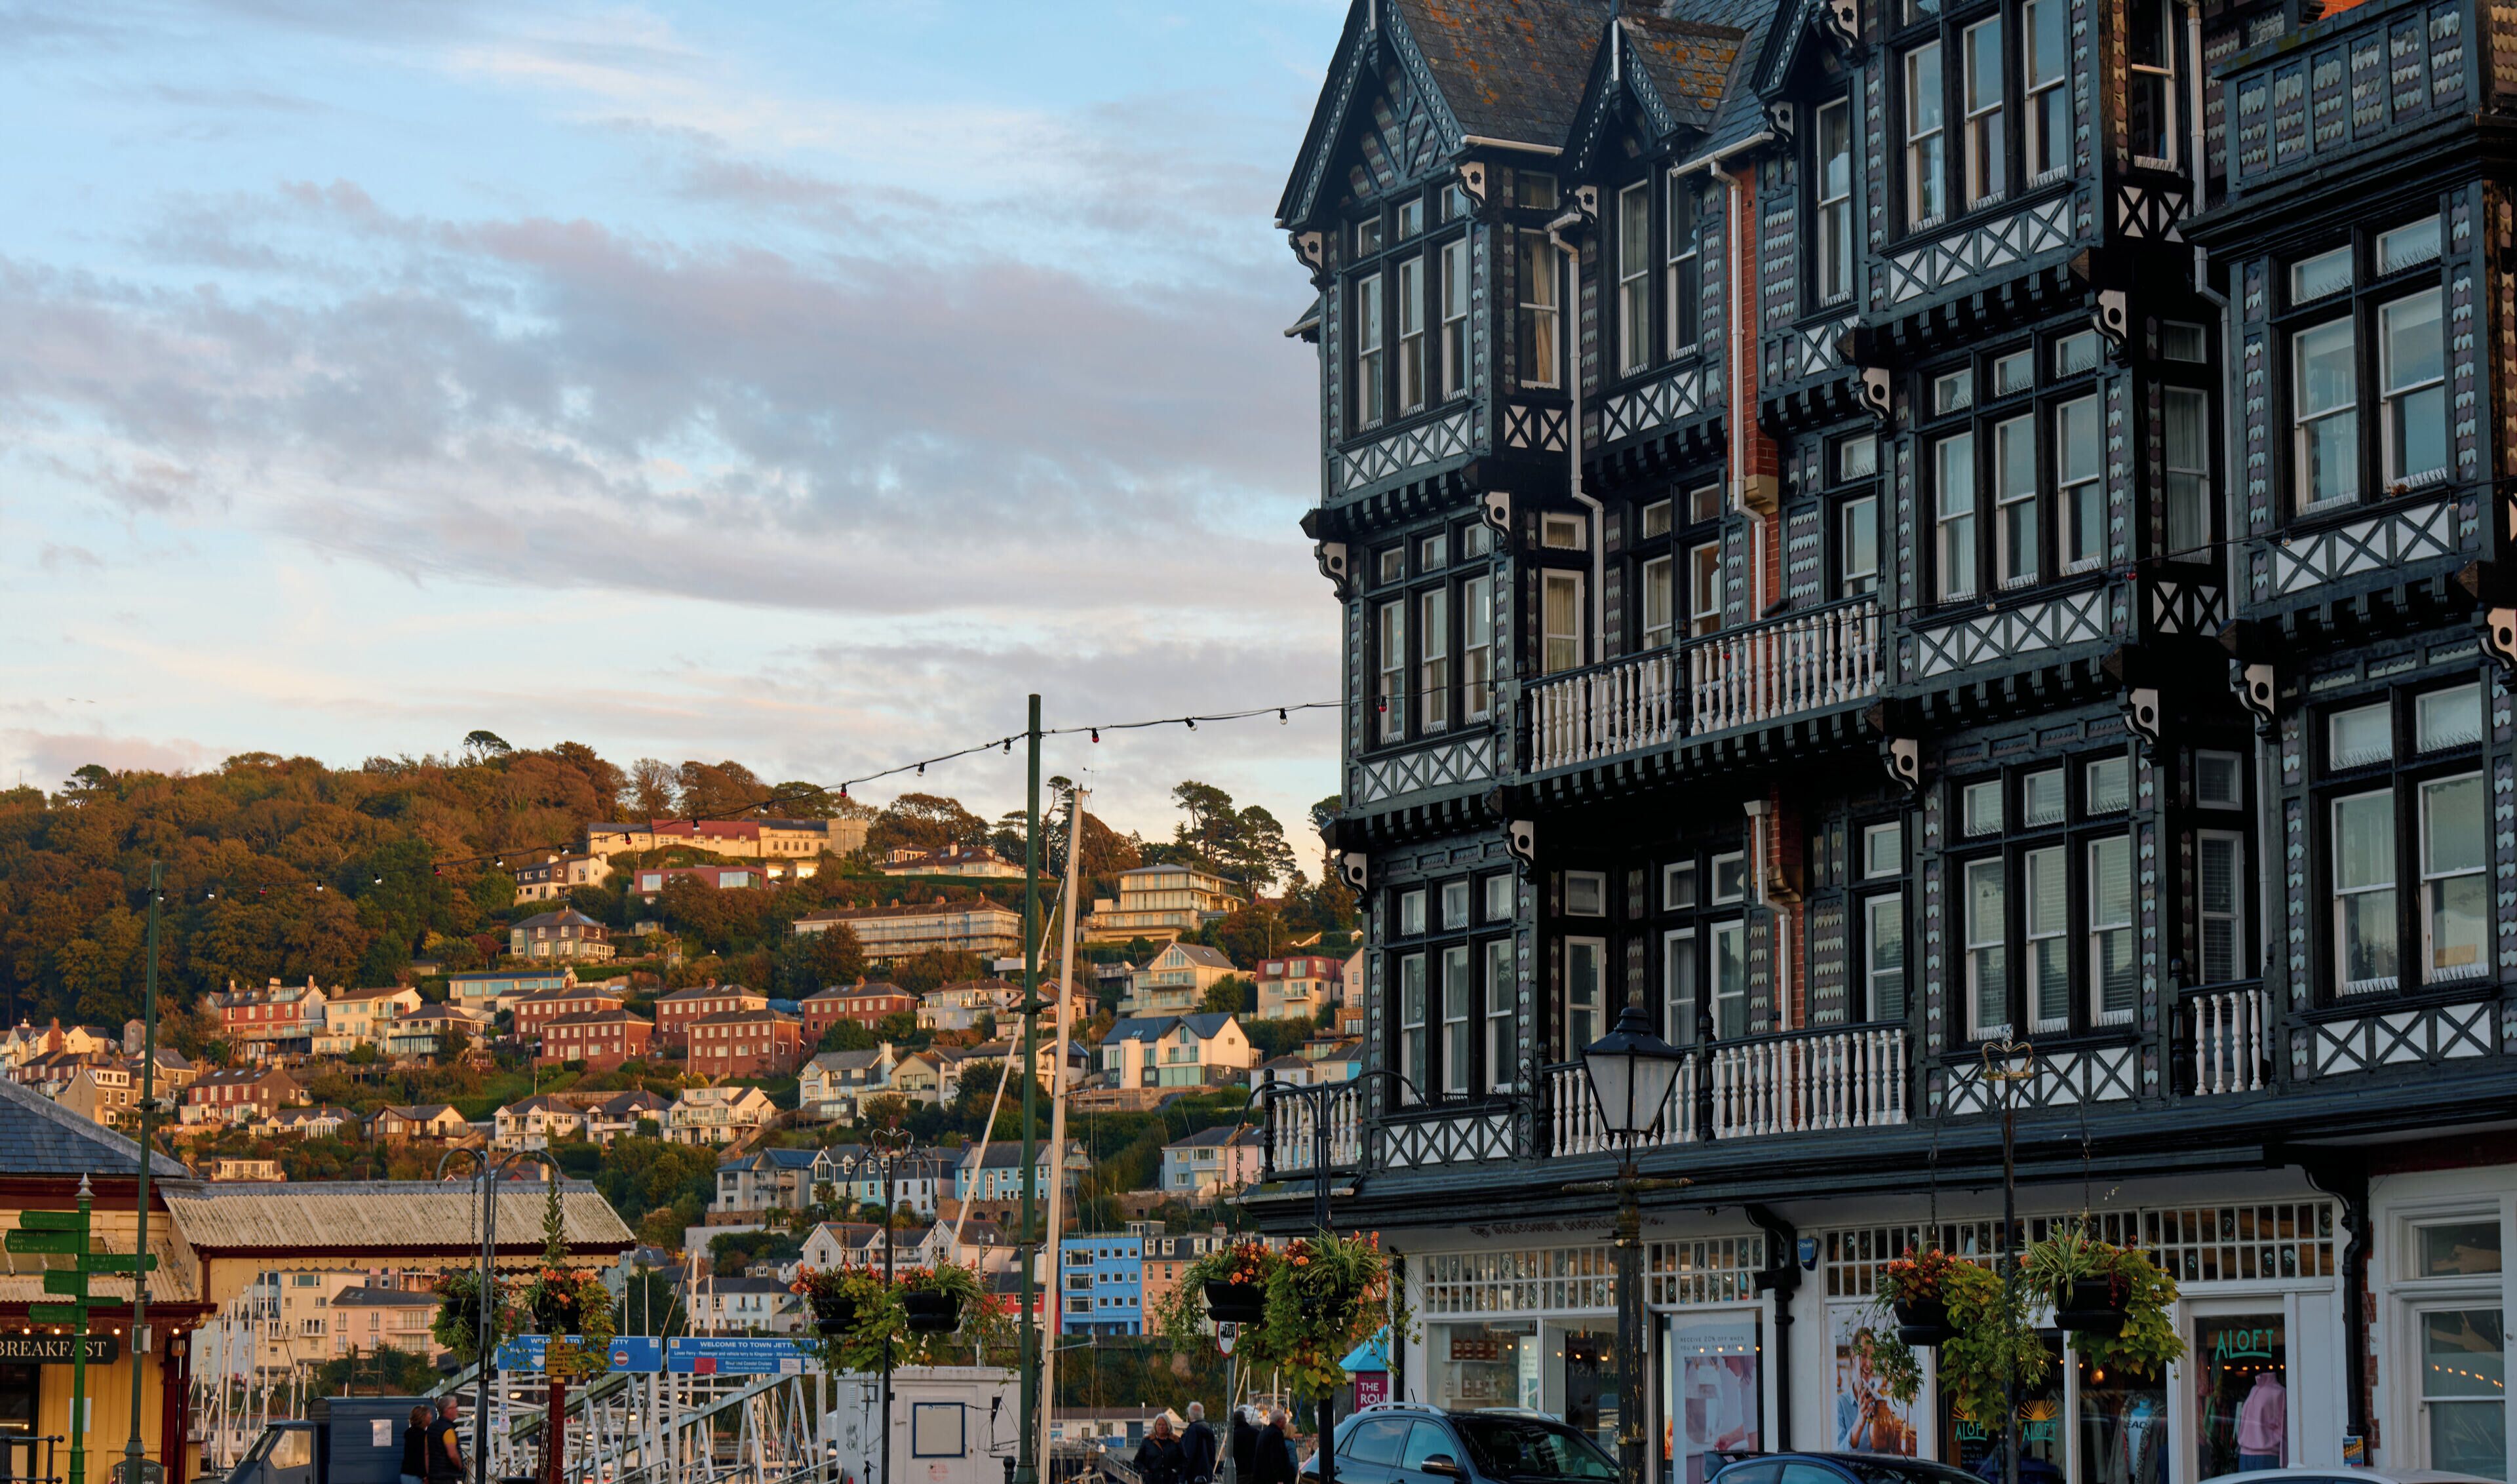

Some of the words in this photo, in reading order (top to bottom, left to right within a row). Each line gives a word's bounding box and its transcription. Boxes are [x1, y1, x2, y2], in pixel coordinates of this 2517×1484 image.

[2215, 1329, 2274, 1361] ALOFT
[1361, 1382, 1379, 1392] THE
[1361, 1394, 1388, 1404] ROU
[2022, 1422, 2056, 1442] ALOFT
